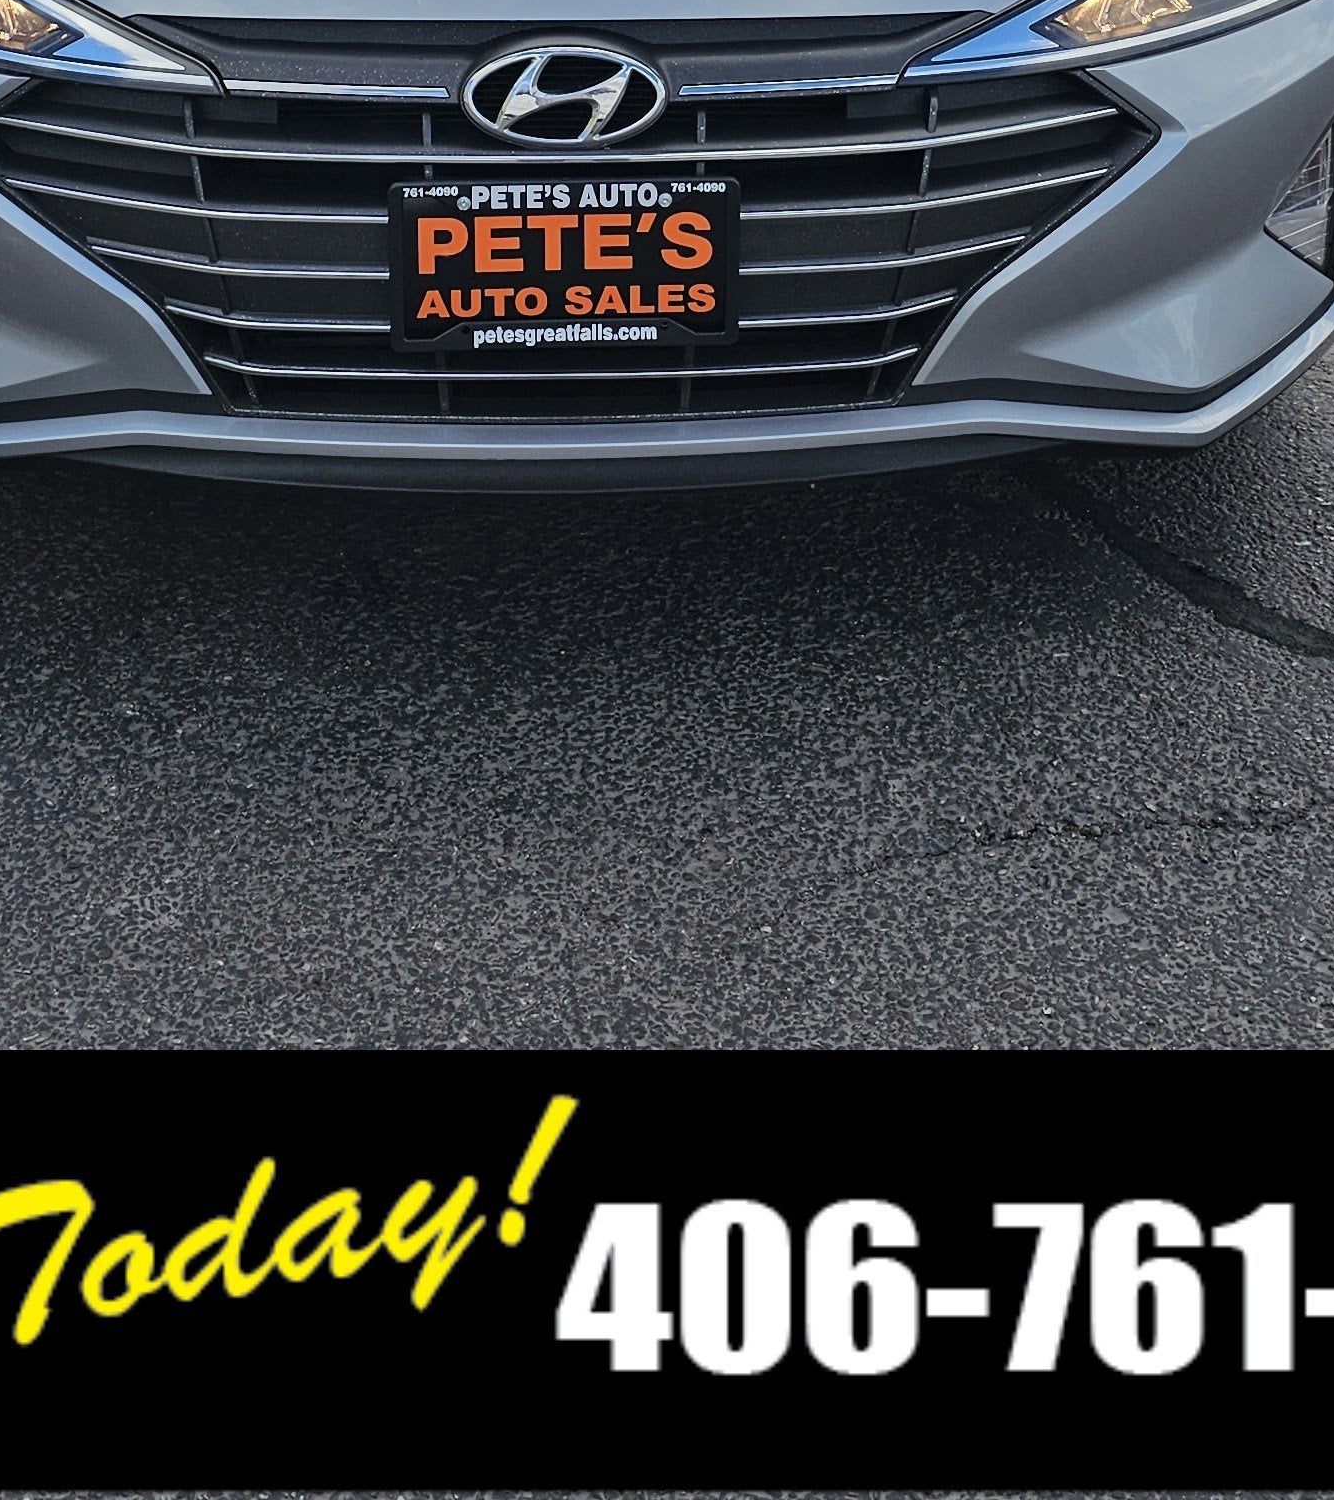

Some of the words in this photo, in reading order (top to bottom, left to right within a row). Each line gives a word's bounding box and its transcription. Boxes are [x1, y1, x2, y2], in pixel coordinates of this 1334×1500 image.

[403, 186, 459, 198] 761-4090
[471, 184, 571, 210] PETE'S
[578, 182, 658, 208] AUTO
[670, 182, 726, 193] 761-4090
[417, 211, 713, 275] PETE'S
[416, 286, 548, 319] AUTO
[564, 283, 716, 315] SALES
[473, 323, 658, 349] petesgreatfalls.com
